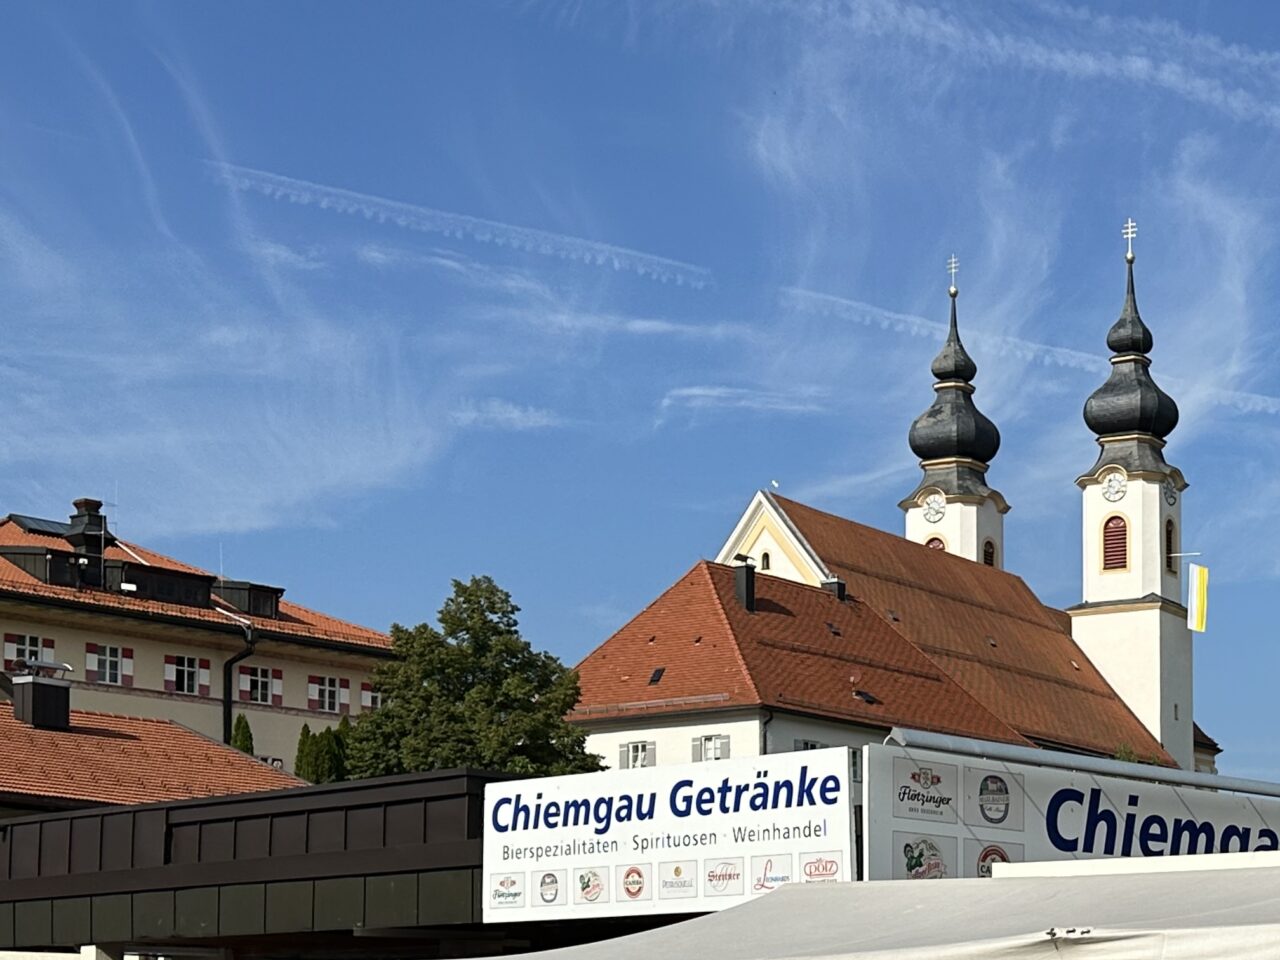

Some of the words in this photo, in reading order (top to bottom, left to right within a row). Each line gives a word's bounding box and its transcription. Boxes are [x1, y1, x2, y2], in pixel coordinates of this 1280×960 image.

[492, 792, 656, 835] Chiemgau
[669, 766, 840, 817] Getränke
[898, 785, 952, 808] Flötzinger
[503, 839, 618, 861] Bierspezialitäten
[632, 831, 717, 854] Spirituosen
[733, 819, 827, 843] Weinhandel
